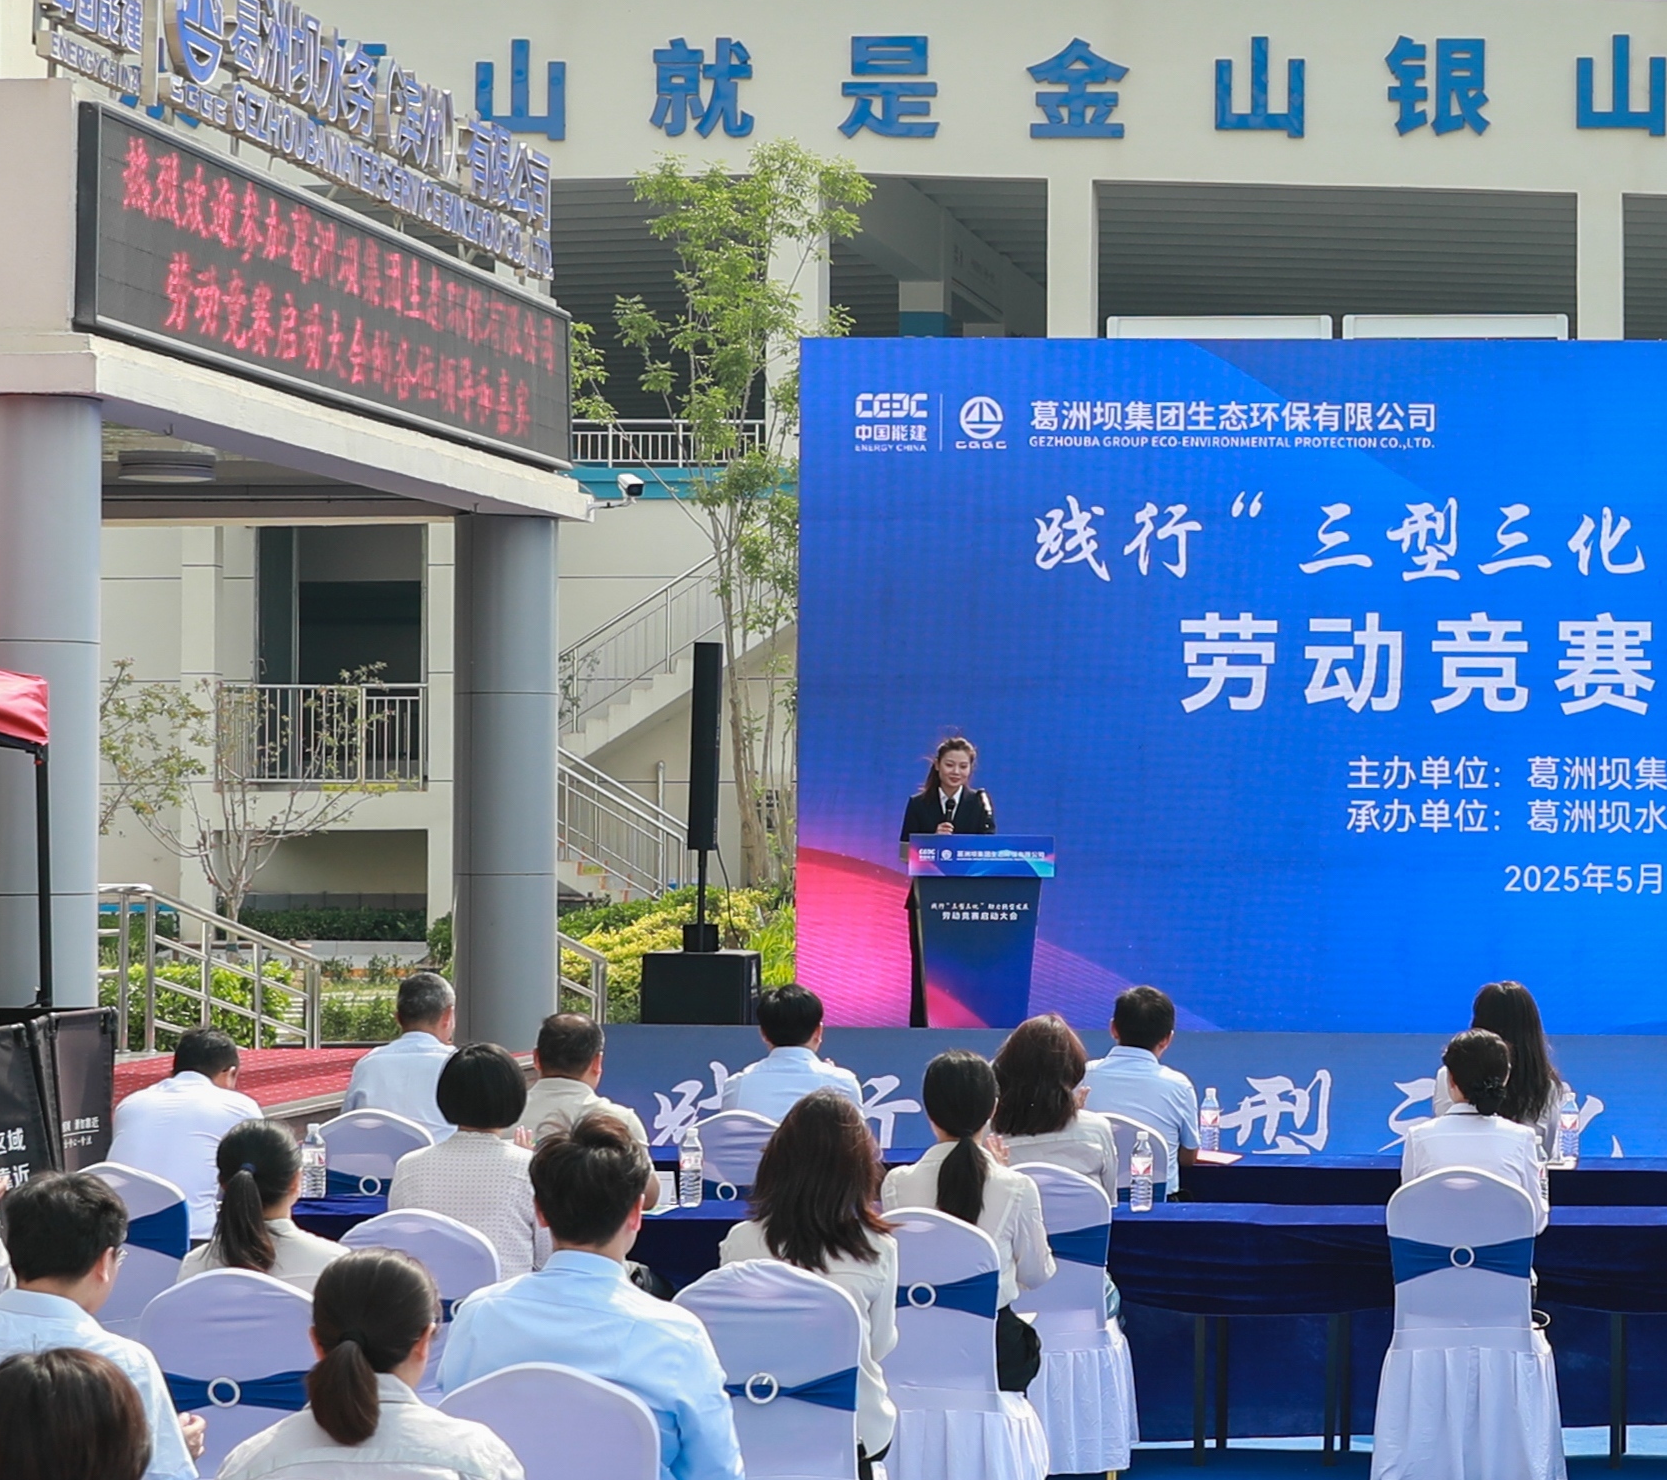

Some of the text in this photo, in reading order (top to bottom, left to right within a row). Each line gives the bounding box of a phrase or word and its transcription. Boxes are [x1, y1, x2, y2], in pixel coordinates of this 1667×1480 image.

[123, 33, 1667, 141] 山就是金山银山
[1030, 399, 1436, 433] 葛洲坝集团生态环保有限公司
[855, 423, 927, 443] 中国能建
[1029, 435, 1100, 449] GEZHOUBA
[1102, 435, 1149, 449] GROUP
[1151, 435, 1291, 449] ECO-ENVIRONMENTAL
[1294, 435, 1377, 450] PROTECTION
[1505, 863, 1662, 895] 2025年5月
